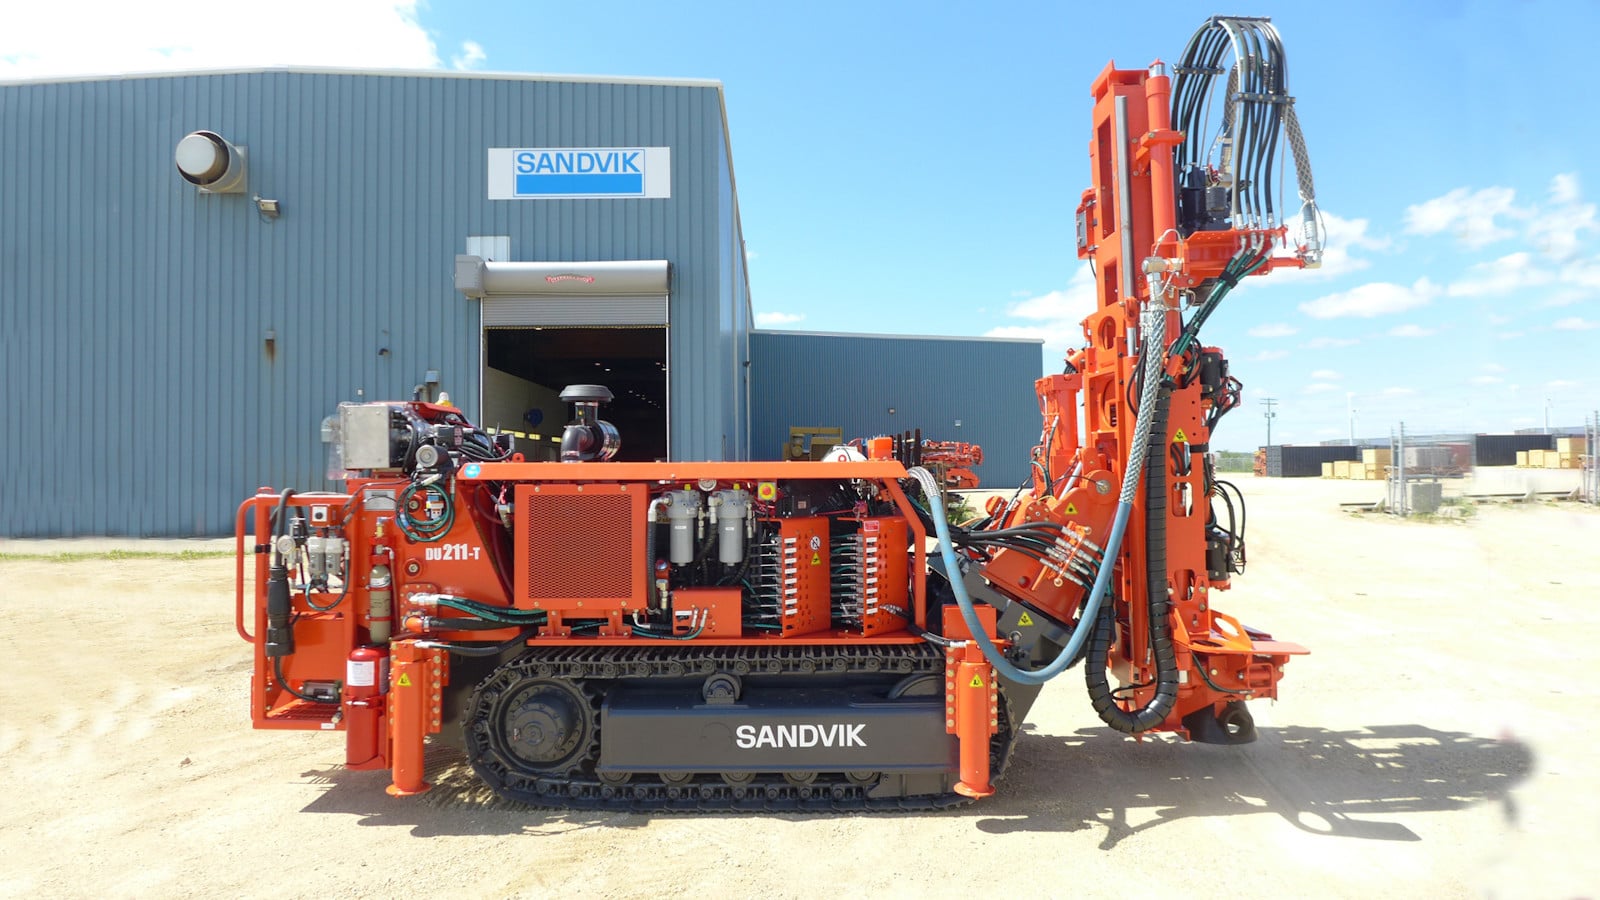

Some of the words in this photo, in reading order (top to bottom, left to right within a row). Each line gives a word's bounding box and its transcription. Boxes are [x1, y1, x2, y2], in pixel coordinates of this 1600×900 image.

[517, 152, 640, 173] SANDVIK
[425, 543, 481, 560] DU211-T
[736, 724, 867, 749] SANDVIK
